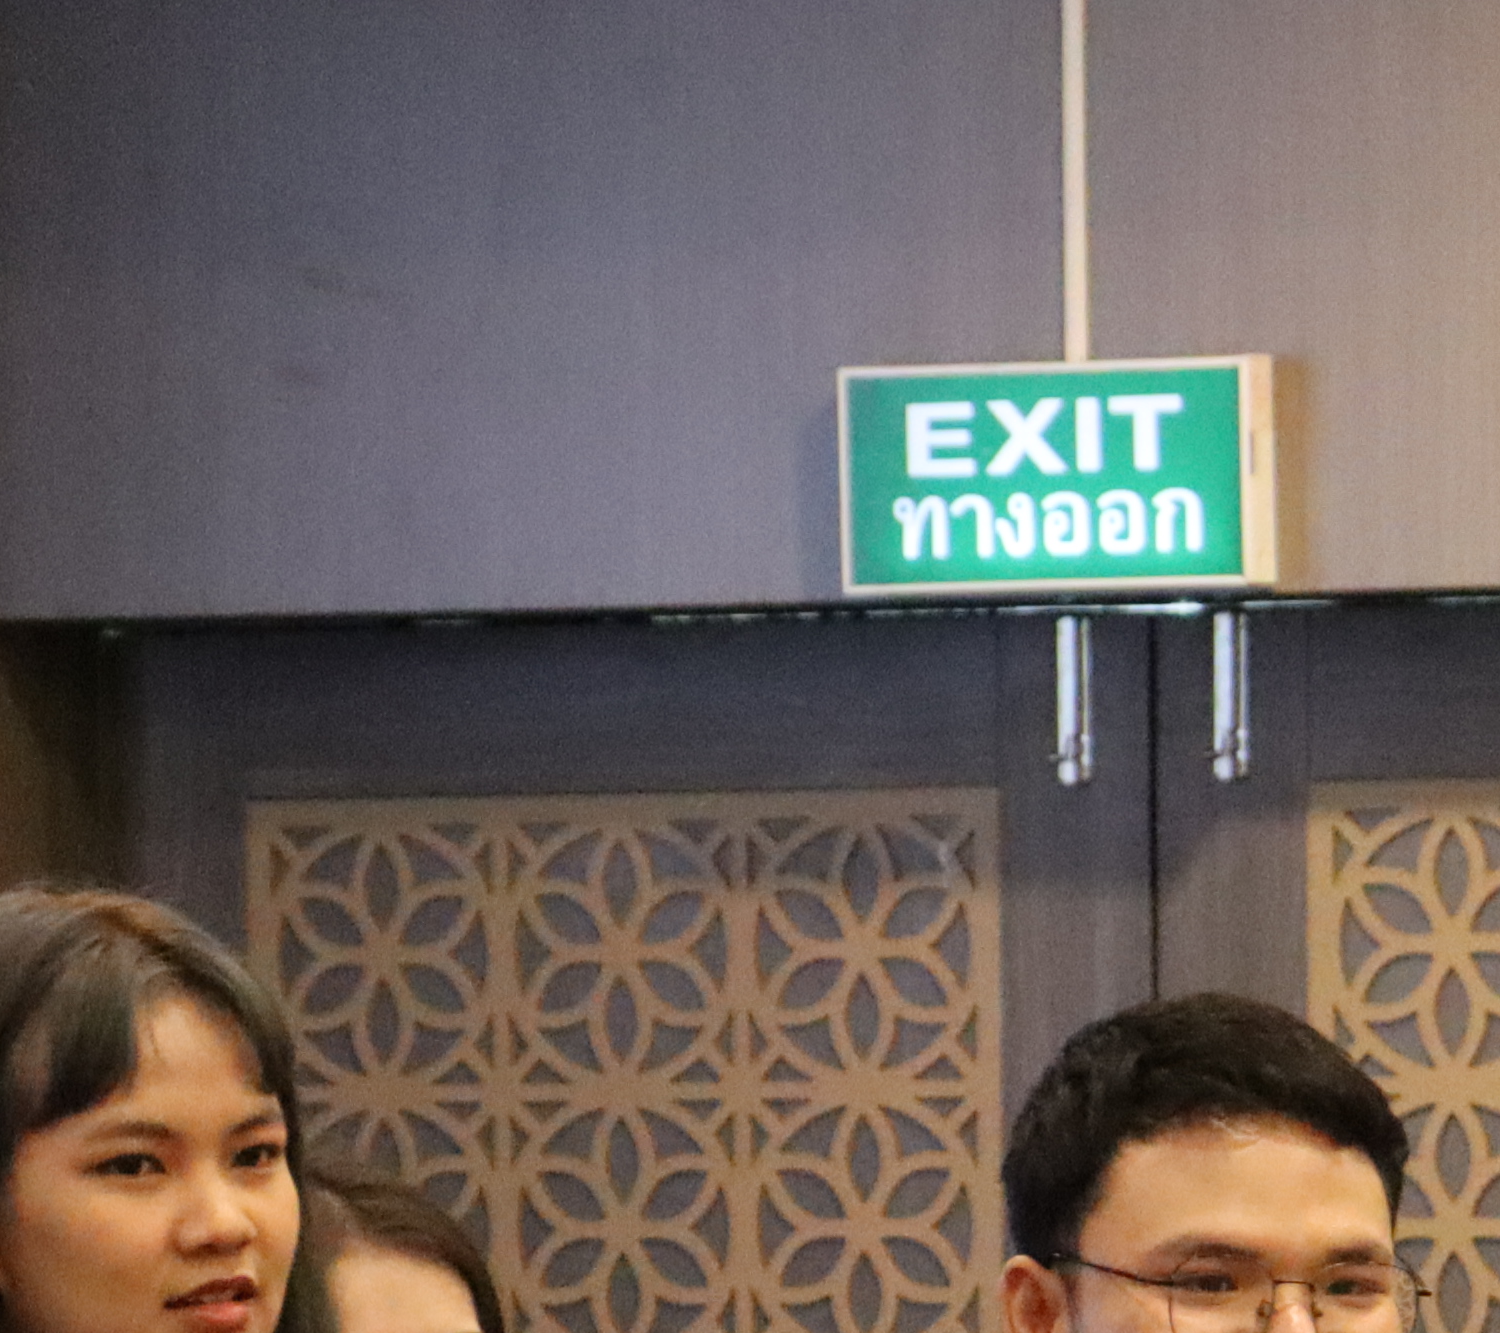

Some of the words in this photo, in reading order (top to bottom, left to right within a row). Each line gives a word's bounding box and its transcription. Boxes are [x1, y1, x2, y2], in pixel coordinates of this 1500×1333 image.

[905, 393, 1184, 478] EXIT
[893, 486, 1204, 559] ทางออก
